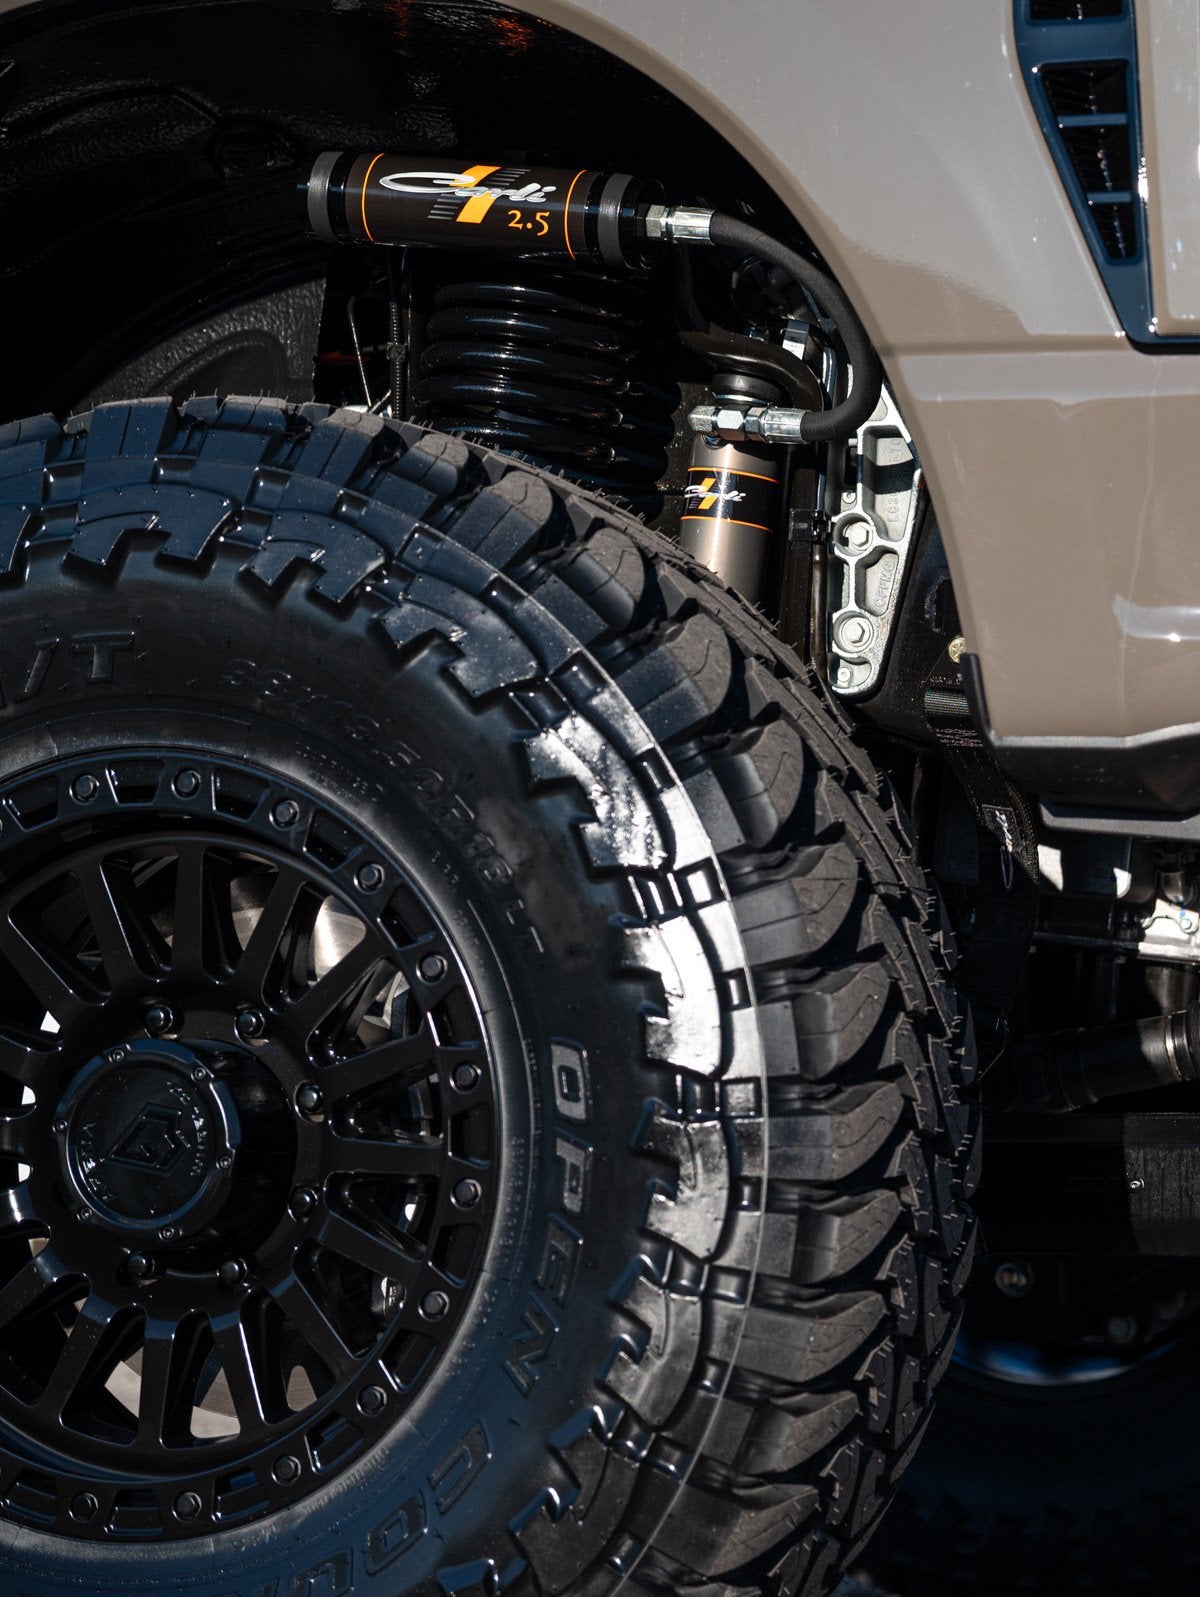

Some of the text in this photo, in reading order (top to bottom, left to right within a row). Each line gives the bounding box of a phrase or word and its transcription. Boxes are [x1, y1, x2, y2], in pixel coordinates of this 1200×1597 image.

[378, 171, 557, 203] Carli
[507, 209, 550, 236] 2.5
[500, 1034, 595, 1397] OPEN
